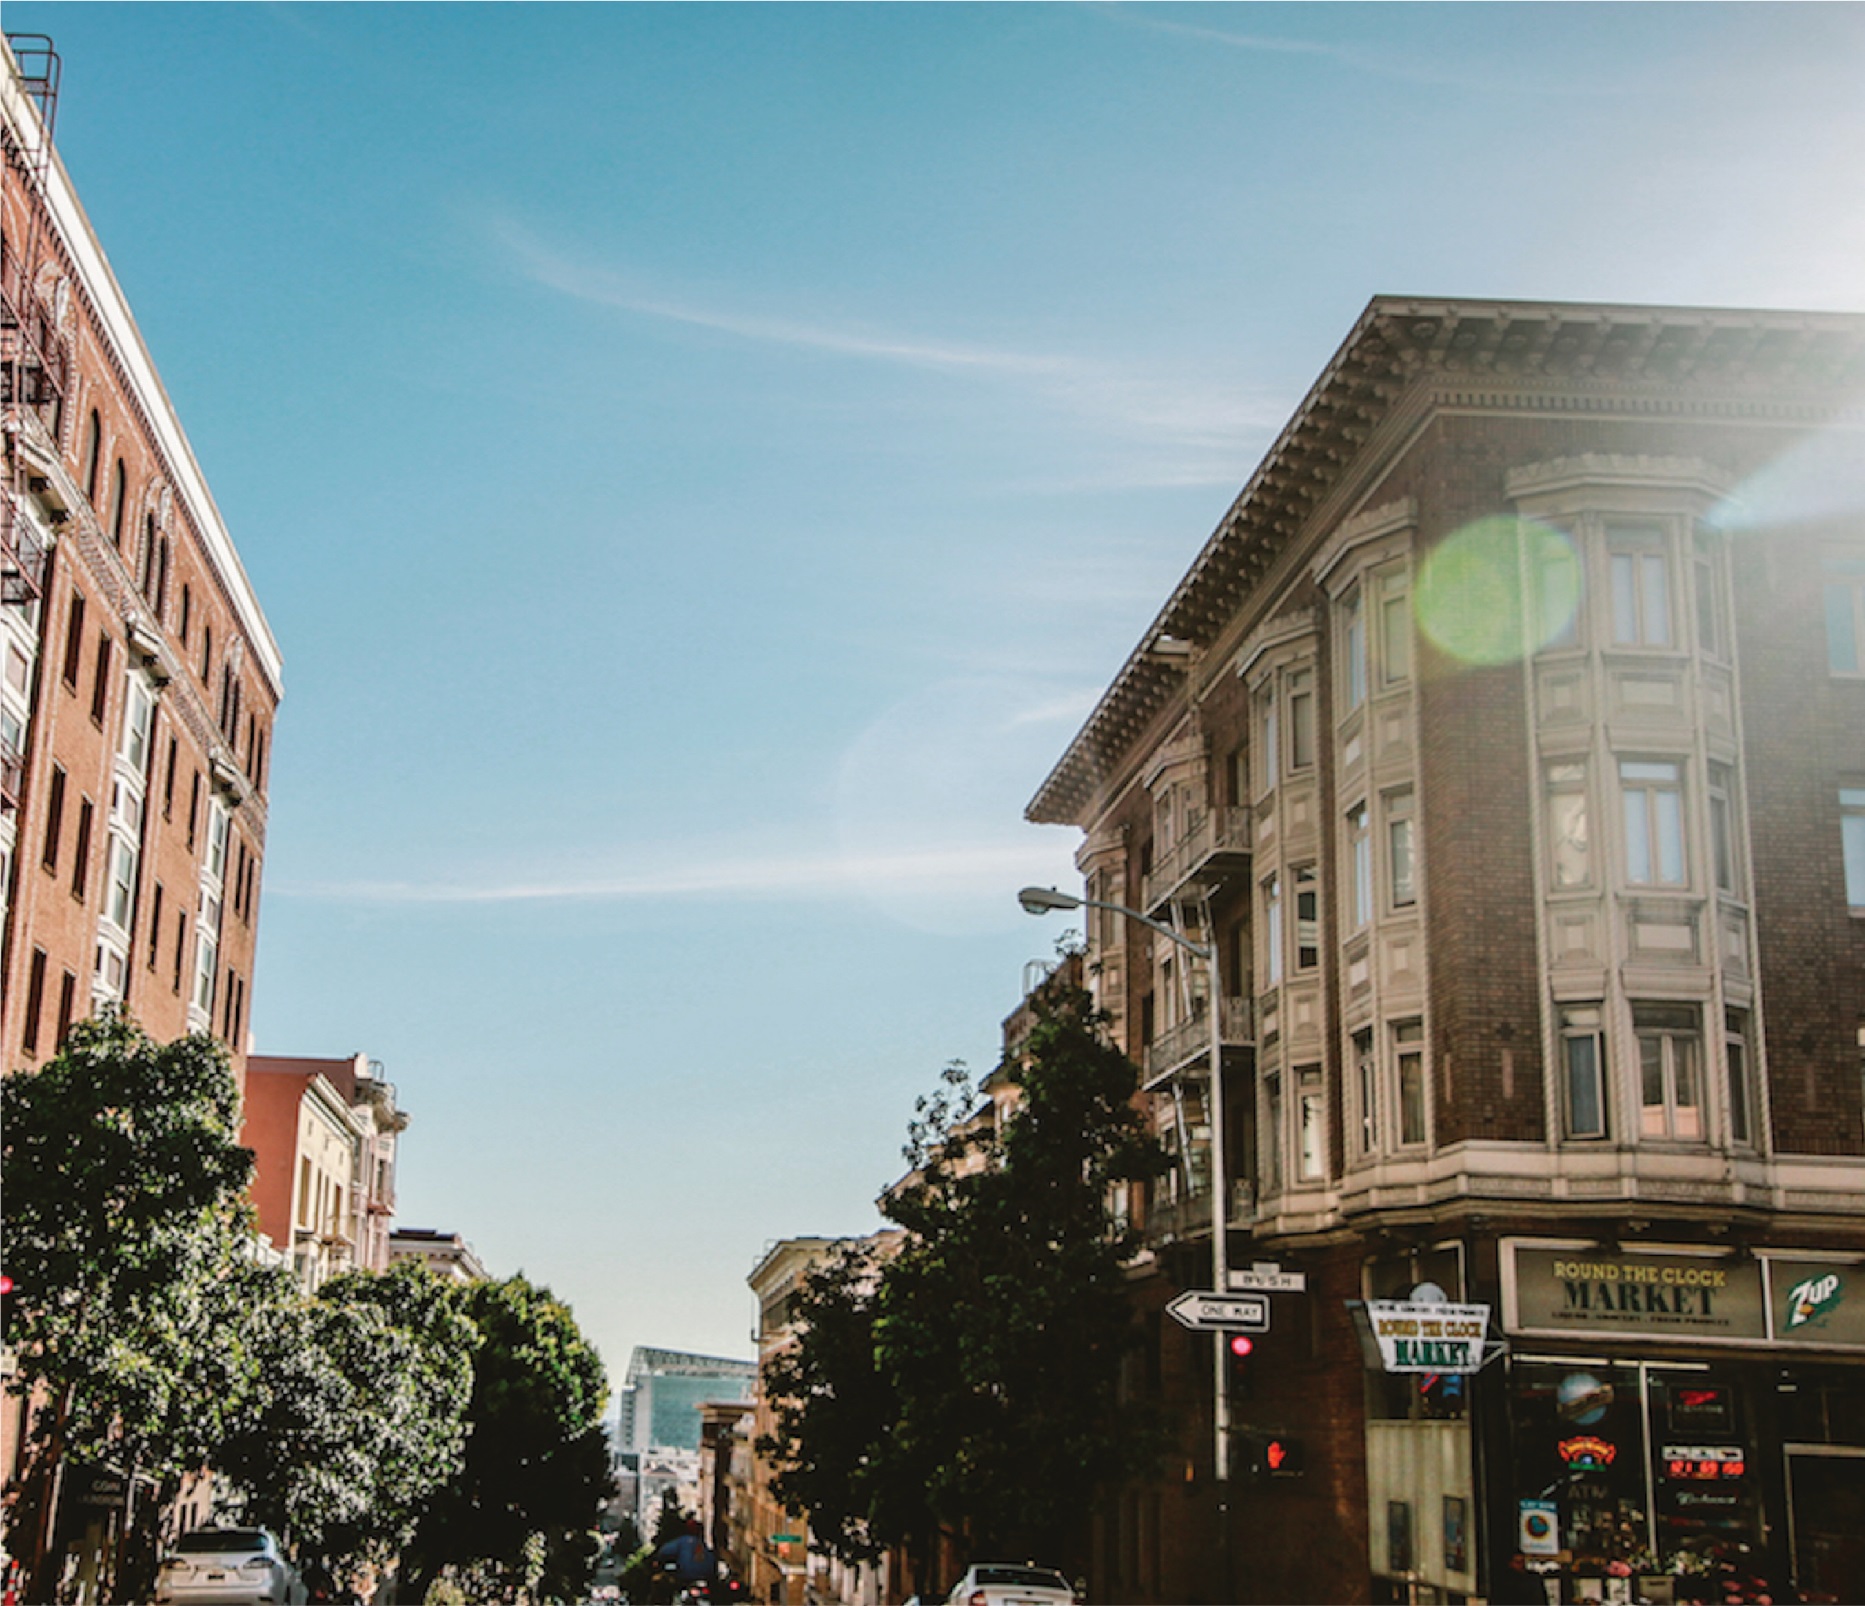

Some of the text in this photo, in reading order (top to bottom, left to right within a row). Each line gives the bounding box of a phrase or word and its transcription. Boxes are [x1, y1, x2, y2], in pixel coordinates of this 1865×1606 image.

[1553, 1260, 1726, 1287] ROUND THE CLOCK
[1202, 1303, 1258, 1317] ONE WAY
[1564, 1281, 1717, 1315] MARKET
[1788, 1274, 1839, 1327] 7UP
[1420, 1320, 1442, 1337] THE
[1445, 1321, 1482, 1337] CLOCK
[1394, 1339, 1470, 1366] MARKET
